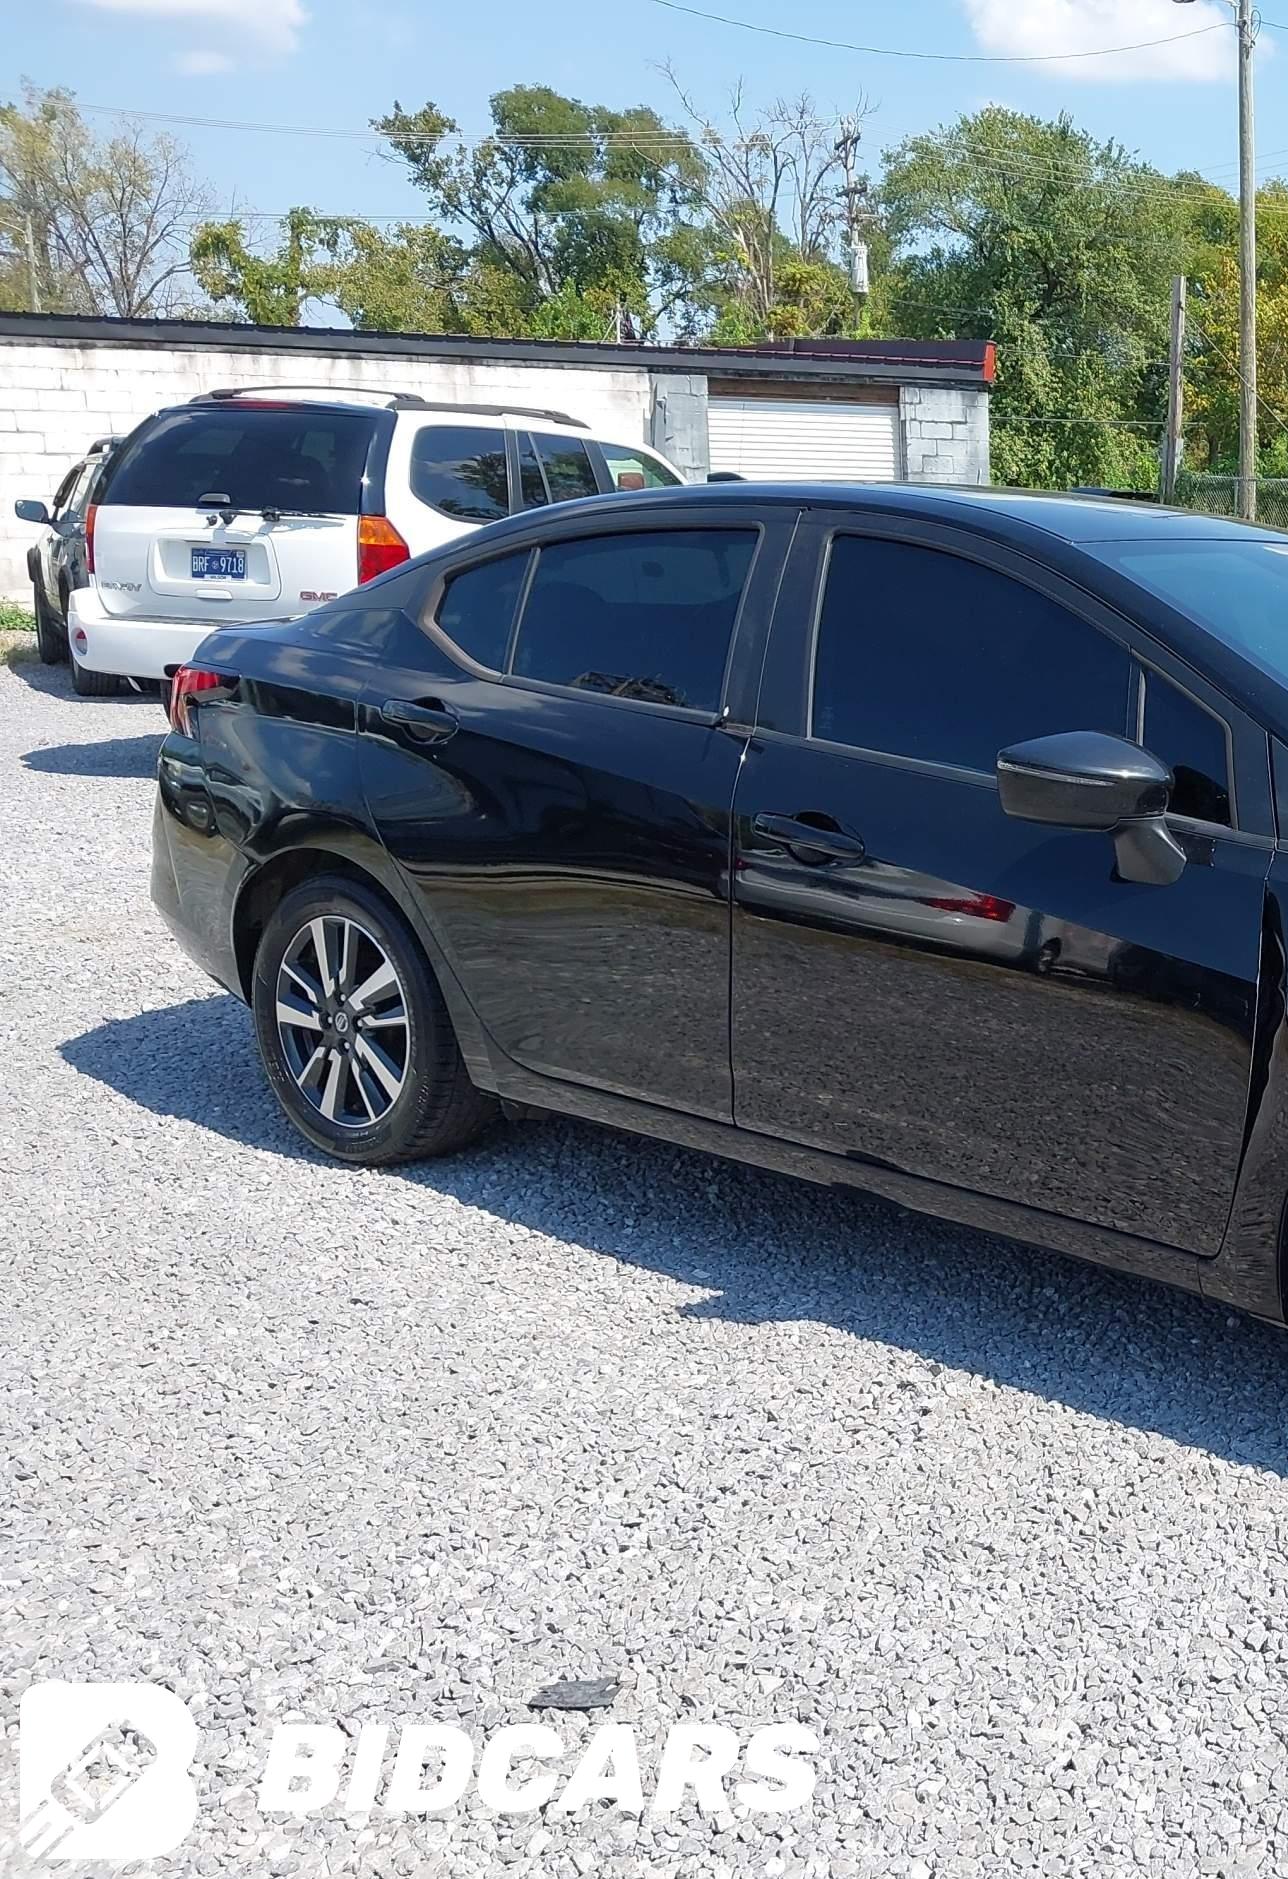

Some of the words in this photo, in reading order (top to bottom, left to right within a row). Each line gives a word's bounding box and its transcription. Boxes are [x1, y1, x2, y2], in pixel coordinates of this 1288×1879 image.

[192, 555, 210, 572] BRF
[219, 557, 244, 574] 9718
[299, 591, 338, 602] GMC
